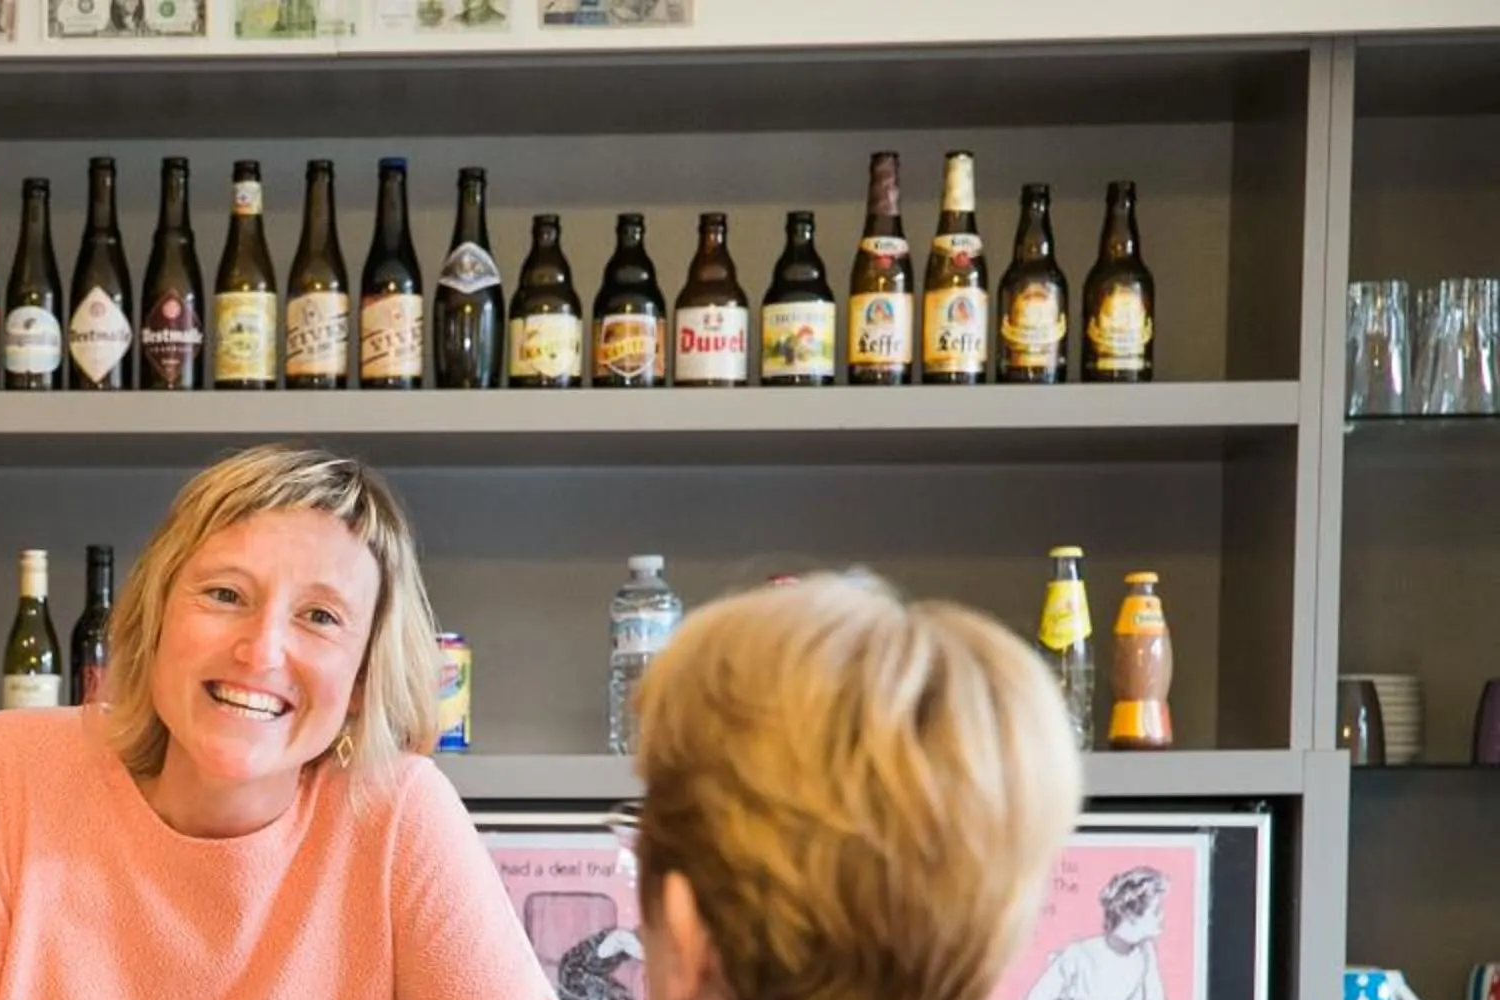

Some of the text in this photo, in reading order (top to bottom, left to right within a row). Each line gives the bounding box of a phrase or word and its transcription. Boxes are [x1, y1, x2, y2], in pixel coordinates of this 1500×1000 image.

[678, 325, 745, 354] Duvel
[858, 330, 902, 356] Leffe
[938, 330, 982, 352] Leffe
[501, 860, 531, 876] had
[534, 862, 543, 876] a
[549, 859, 581, 876] deal
